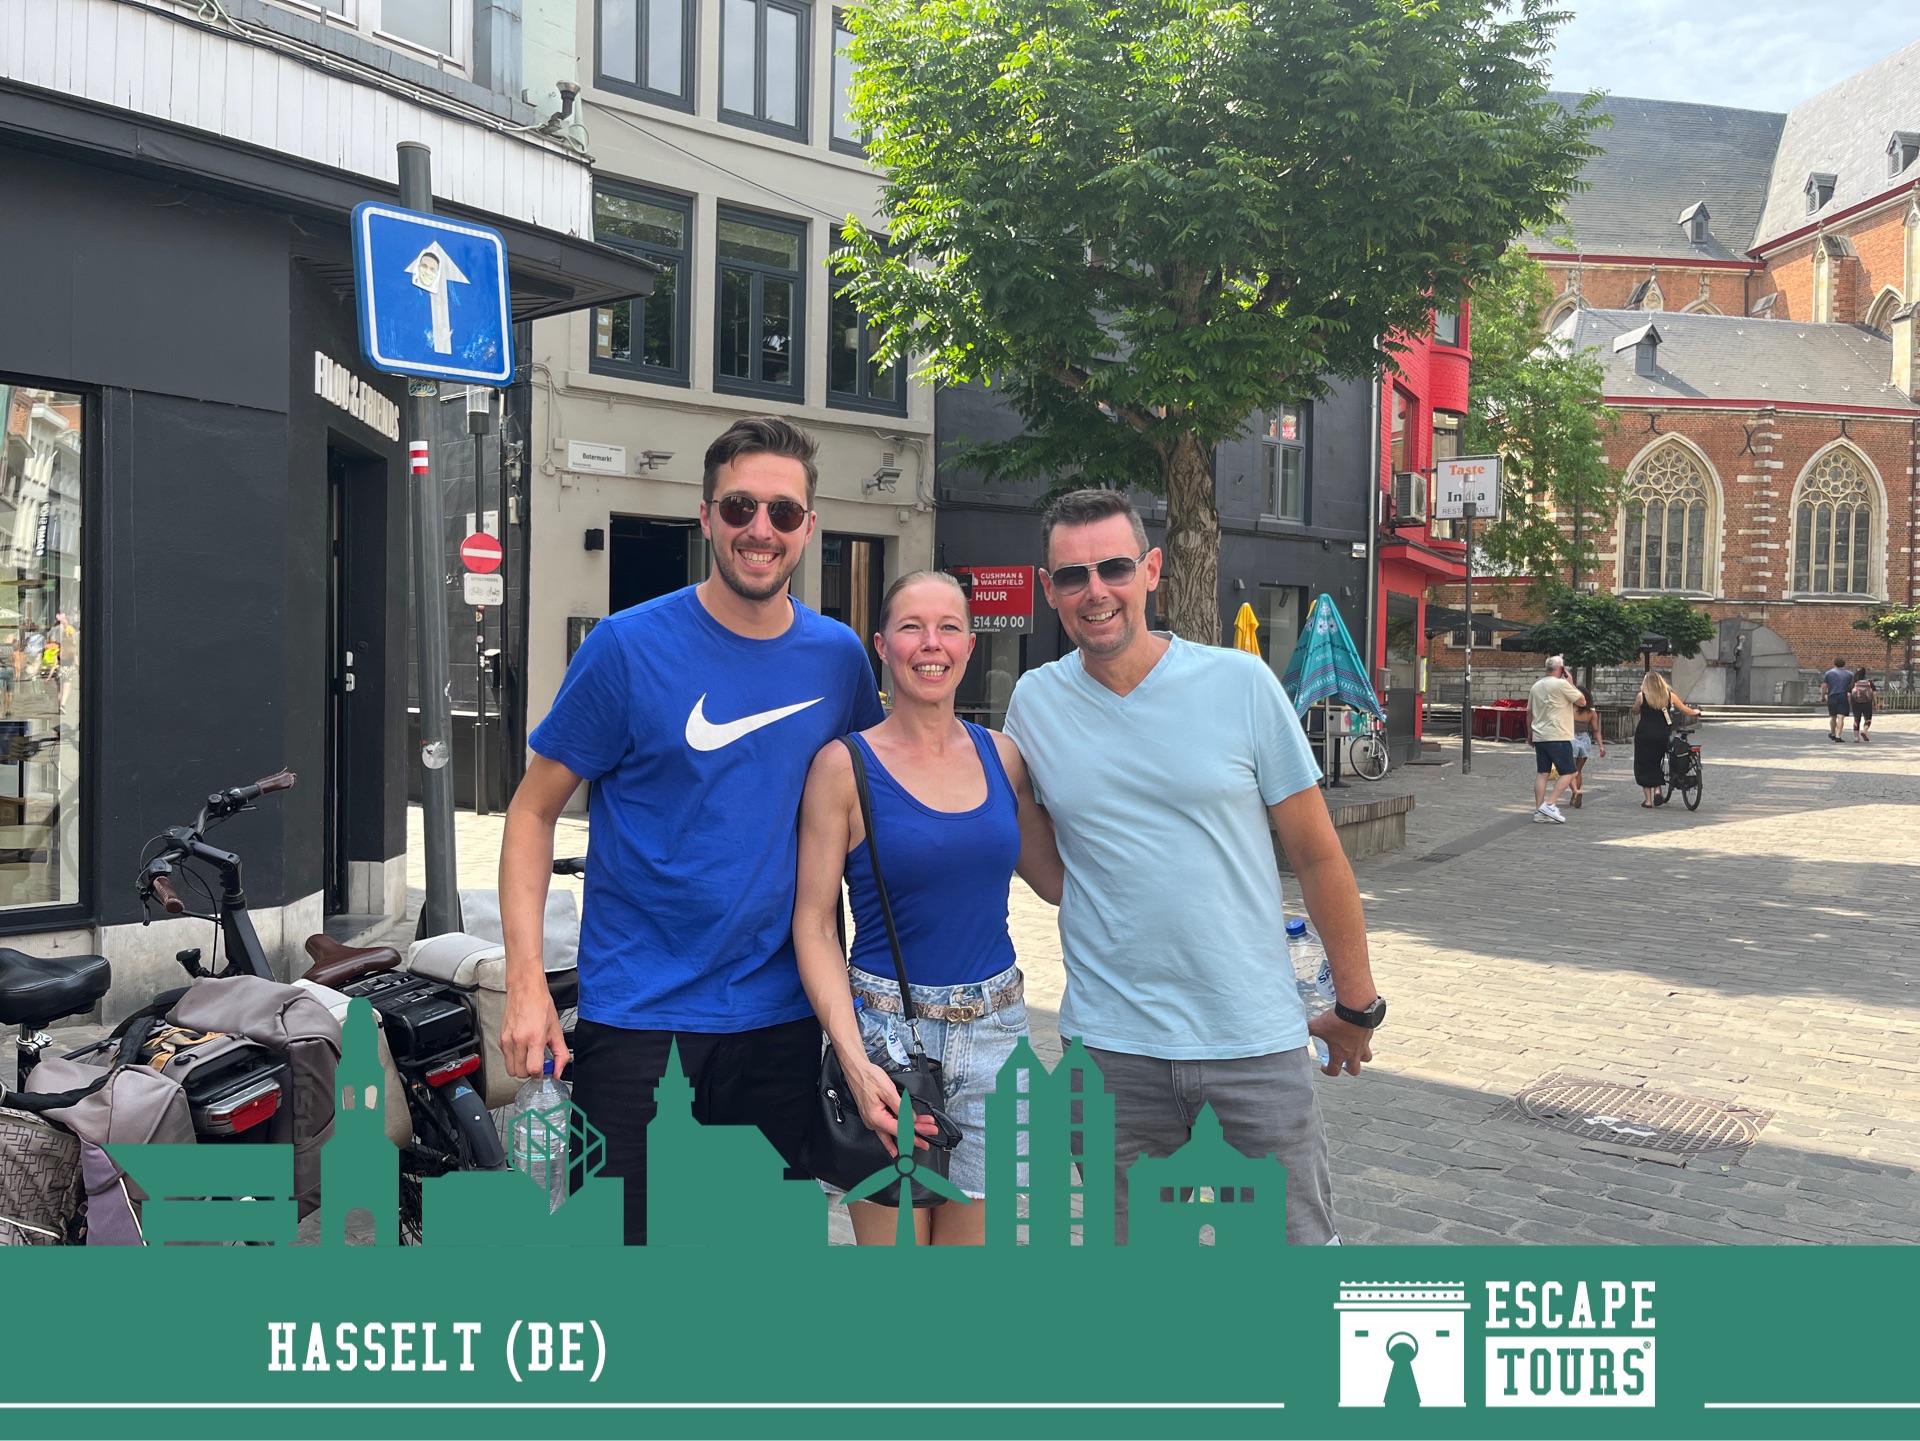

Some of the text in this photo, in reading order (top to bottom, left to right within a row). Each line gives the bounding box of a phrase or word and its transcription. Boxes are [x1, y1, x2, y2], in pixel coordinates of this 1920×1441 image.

[315, 350, 351, 410] FILOU
[358, 381, 400, 442] FRIENDS
[582, 452, 612, 462] Botermarkt
[1448, 464, 1485, 476] Taste
[1442, 506, 1490, 515] RESTANT
[975, 591, 1008, 601] HUUR
[973, 616, 1025, 628] 514 40 00
[1317, 969, 1331, 984] SP
